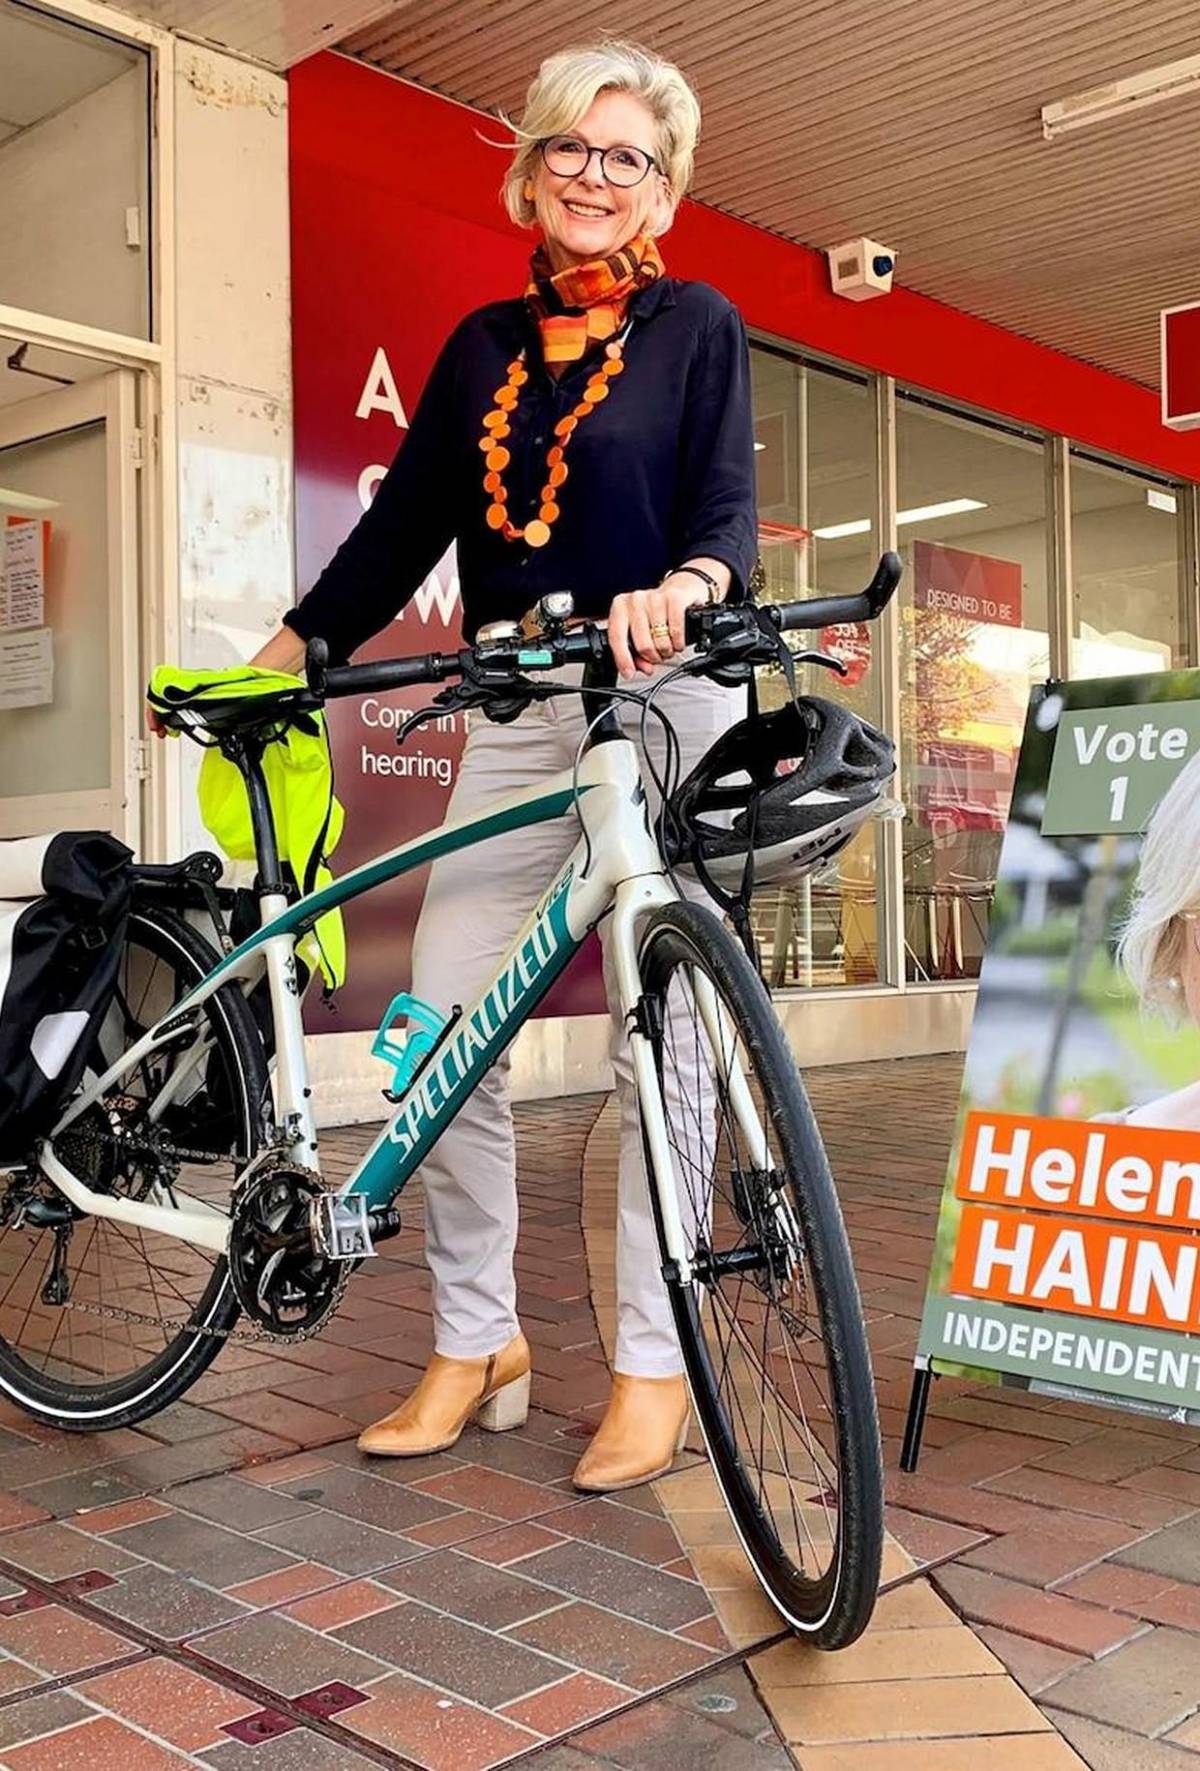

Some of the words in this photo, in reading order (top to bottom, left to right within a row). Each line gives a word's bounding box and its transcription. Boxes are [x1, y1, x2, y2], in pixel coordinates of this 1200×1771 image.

[355, 346, 409, 430] A
[927, 588, 979, 614] DESIGNED
[981, 599, 997, 617] TO
[999, 603, 1013, 620] BE
[361, 746, 452, 786] hearing
[1073, 723, 1188, 765] Vote
[1109, 776, 1129, 822] 1
[390, 913, 558, 1164] SPECIALIZED
[968, 1124, 1200, 1220] Helen
[972, 1218, 1200, 1326] HAIN
